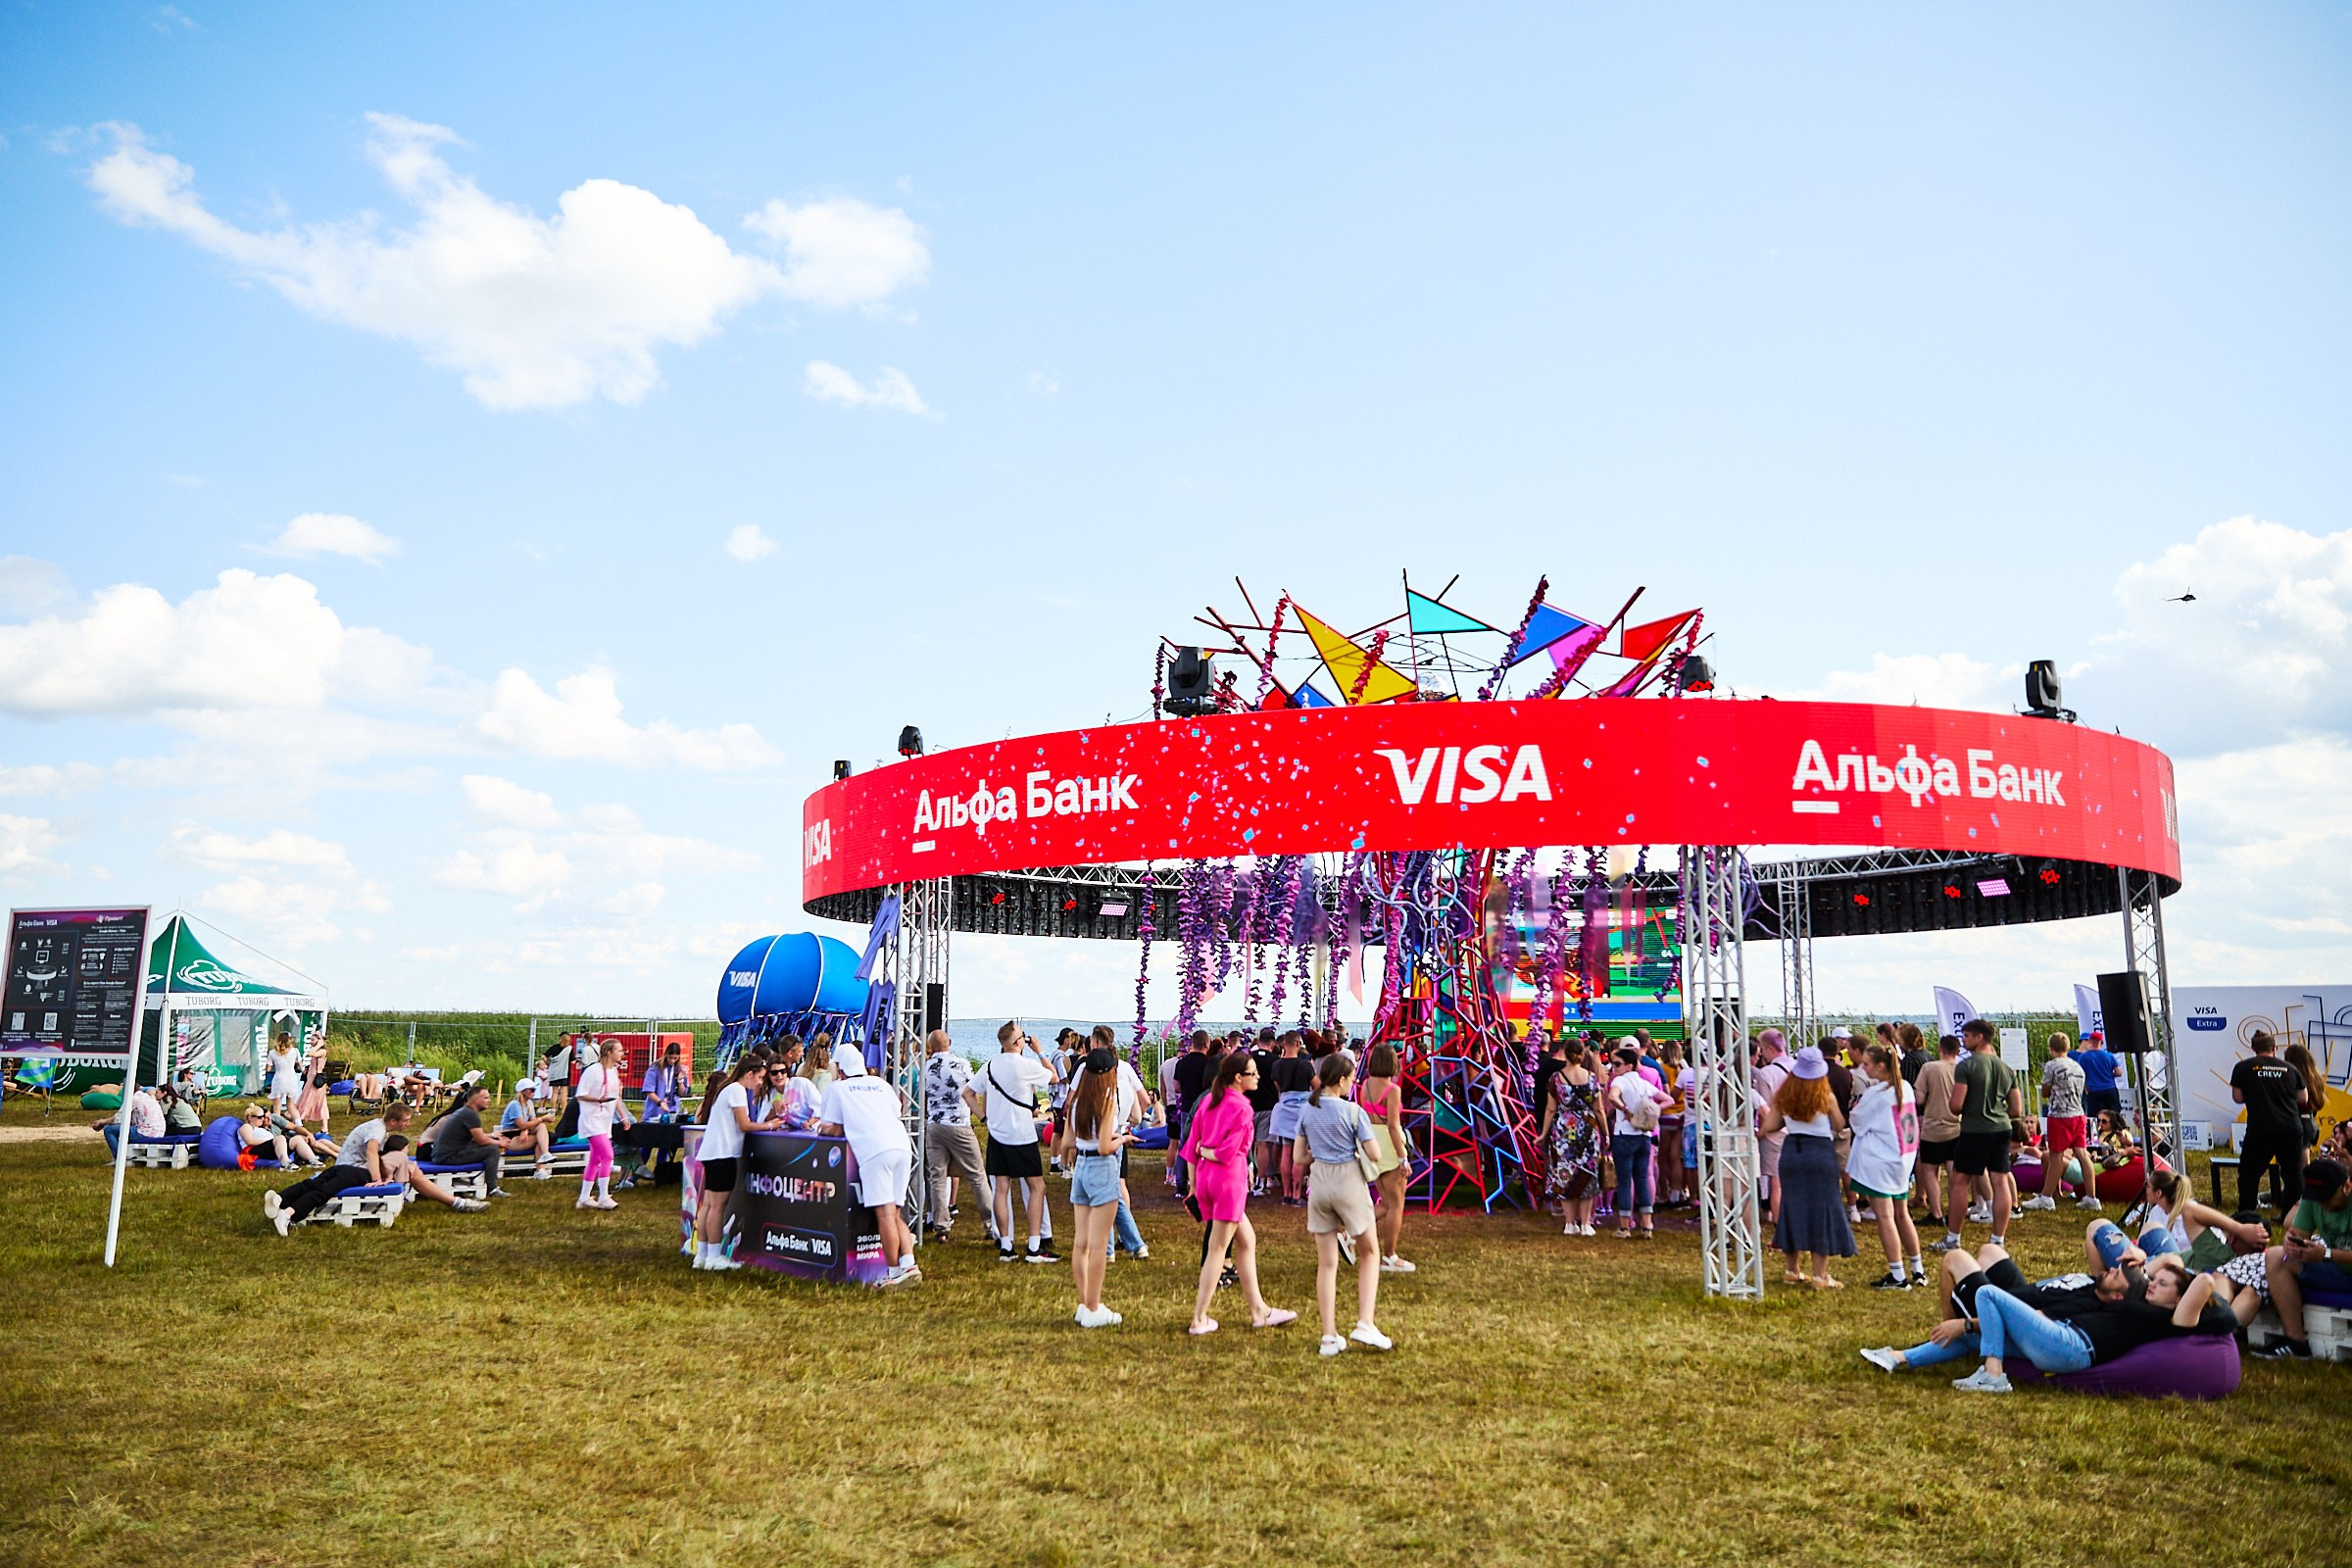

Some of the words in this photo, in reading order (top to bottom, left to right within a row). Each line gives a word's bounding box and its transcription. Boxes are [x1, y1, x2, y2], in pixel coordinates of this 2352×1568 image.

[1373, 745, 1553, 805] VISA
[1792, 740, 1961, 808] Альфа
[1967, 749, 2066, 807] Банк
[912, 779, 1018, 836] Альфа
[1026, 770, 1140, 817] Банк
[804, 818, 832, 870] VISA
[729, 970, 758, 988] VISA
[185, 996, 221, 1006] TUBORG
[236, 996, 270, 1006] TUBORG
[283, 997, 315, 1007] TUBORG
[2193, 1006, 2218, 1015] VISA
[207, 1075, 237, 1086] TUBORG
[765, 1230, 789, 1250] Альфа
[789, 1234, 808, 1251] Банк
[811, 1238, 832, 1255] VISA
[857, 1250, 880, 1260] МИРА
